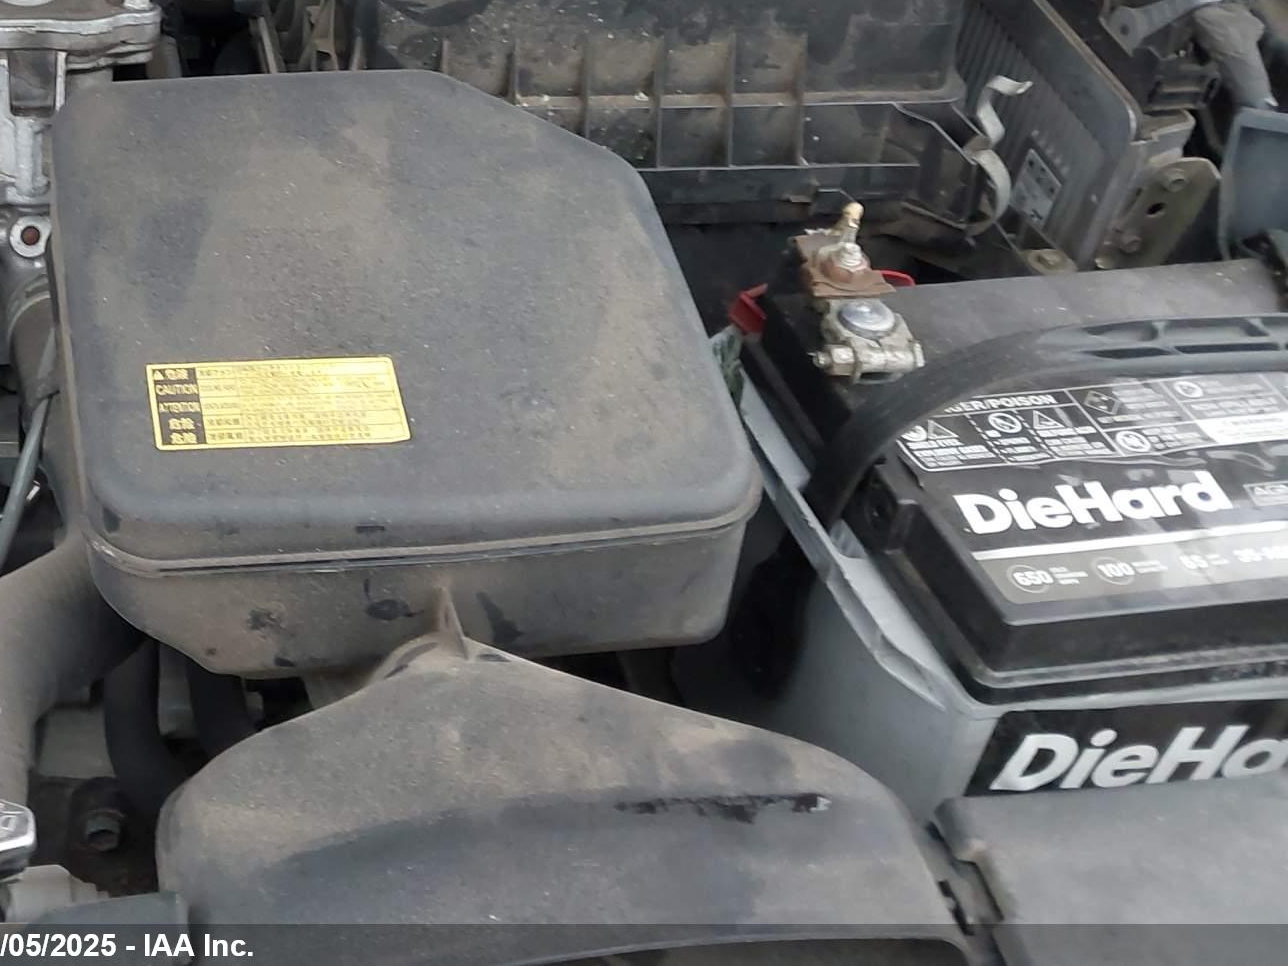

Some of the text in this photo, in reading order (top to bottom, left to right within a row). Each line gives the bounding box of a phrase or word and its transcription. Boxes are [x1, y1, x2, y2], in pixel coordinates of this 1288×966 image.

[155, 384, 199, 395] CAUTION
[158, 402, 202, 413] ATTENTION
[952, 470, 1233, 534] DieHard
[1013, 570, 1054, 586] 650
[1097, 562, 1136, 578] 100
